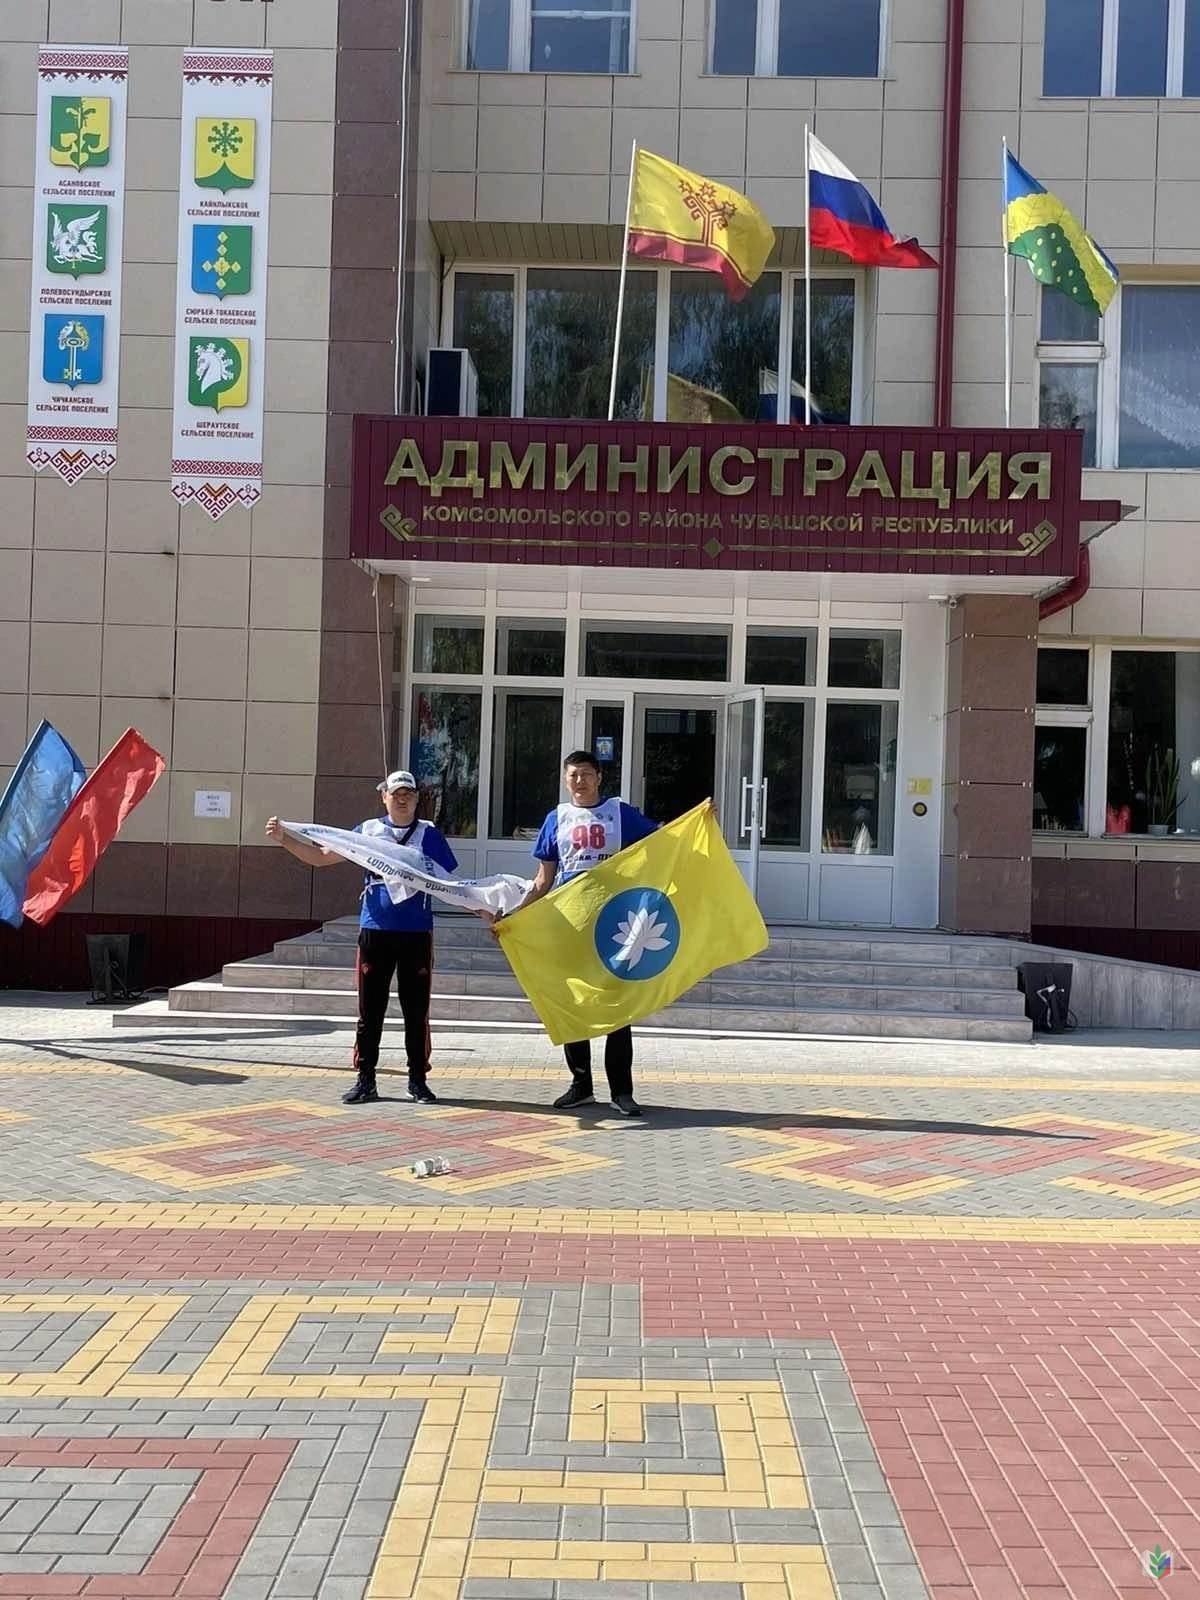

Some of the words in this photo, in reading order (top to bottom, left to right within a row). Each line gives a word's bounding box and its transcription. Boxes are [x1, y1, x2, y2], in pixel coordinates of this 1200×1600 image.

[58, 180, 101, 188] АСАНОВСКОЕ
[42, 188, 76, 196] СЕЛЬСКОЕ
[78, 189, 116, 197] ПОСЕЛЕНИЕ
[187, 209, 221, 217] СЕЛЬСКОЕ
[222, 210, 261, 218] ПОСЕЛЕНИЕ
[41, 288, 112, 298] ПОЛЕВОСУНДЫРСКОЕ
[39, 297, 73, 305] СЕЛЬСКОЕ
[74, 298, 113, 306] ПОСЕЛЕНИЕ
[184, 316, 218, 325] СЕЛЬСКОЕ
[219, 318, 257, 326] ПОСЕЛЕНИЕ
[35, 404, 70, 412] СЕЛЬСКОЕ
[71, 405, 110, 414] ПОСЕЛЕНИЕ
[196, 421, 240, 430] ШЕРАУТСКОЕ
[181, 429, 215, 438] СЕЛЬСКОЕ
[216, 431, 254, 439] ПОСЕЛЕНИЕ
[384, 437, 1052, 509] АДМИНИСТРАЦИЯ
[422, 505, 631, 528] КОМСОМОЛЬСКОГО
[638, 508, 724, 530] РАЙОНА
[731, 513, 863, 533] ЧУВАШСКОЙ
[871, 516, 1014, 535] РЕСПУБЛИКИ
[572, 823, 606, 850] 98
